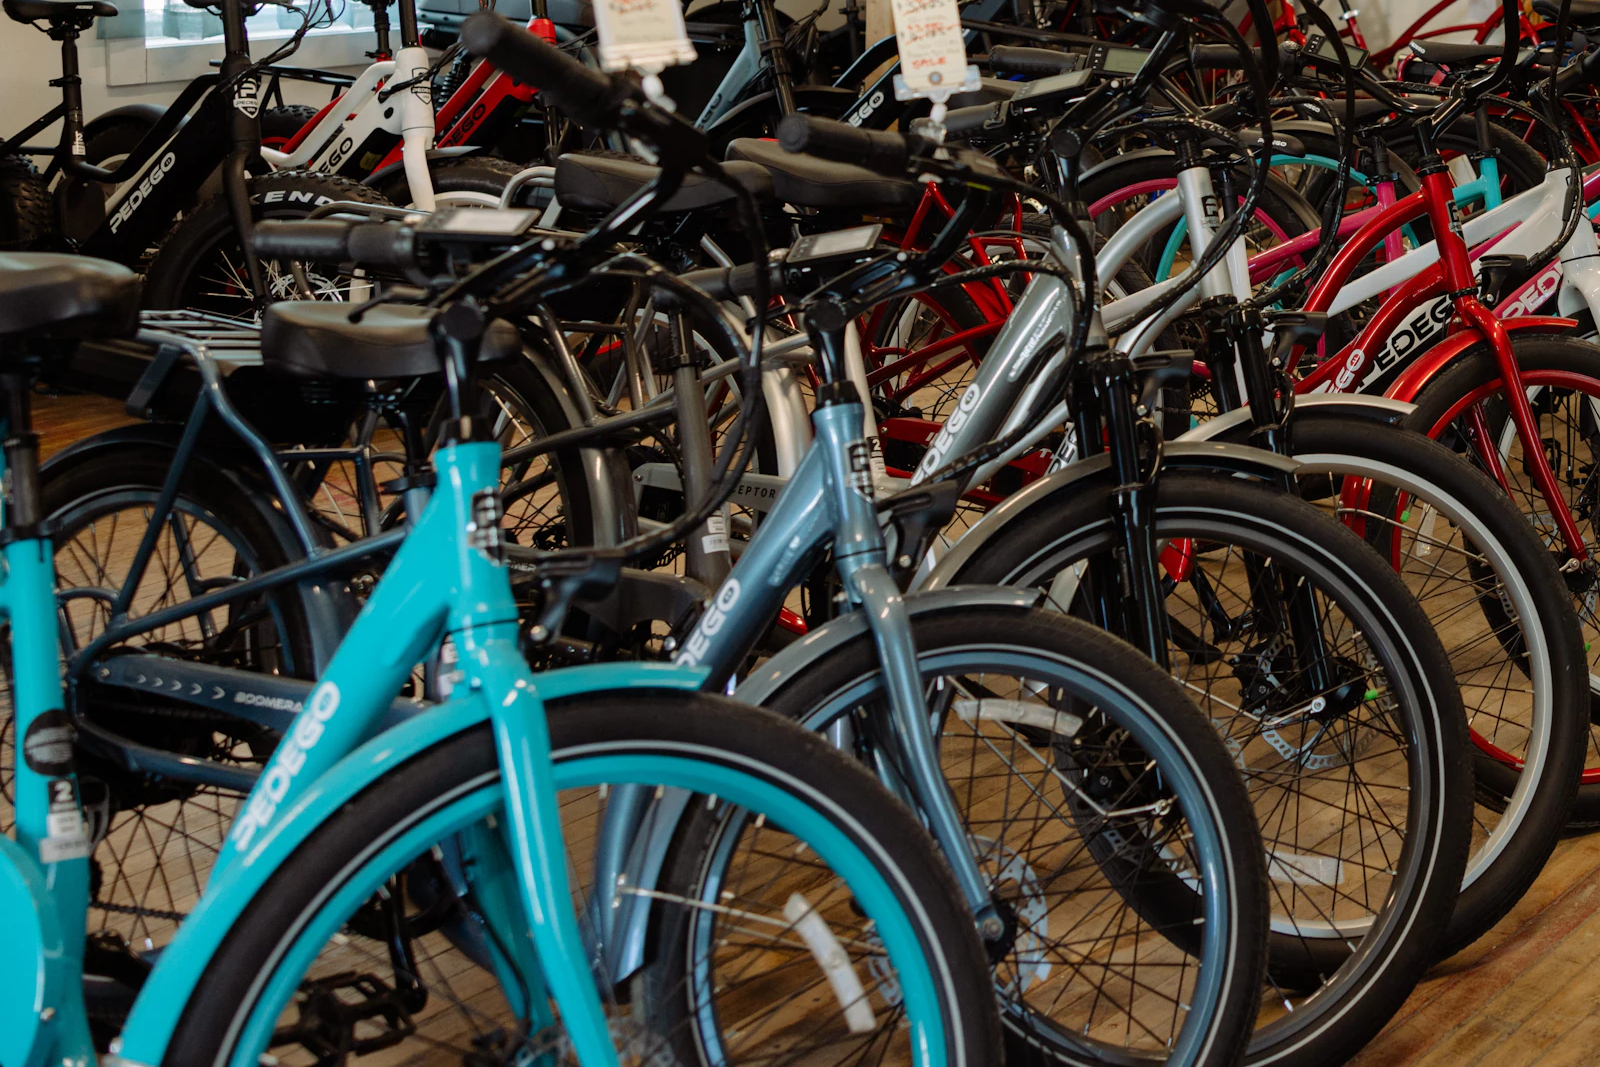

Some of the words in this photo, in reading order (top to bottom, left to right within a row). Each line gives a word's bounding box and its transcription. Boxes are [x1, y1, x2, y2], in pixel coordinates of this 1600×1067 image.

[912, 56, 947, 70] SALE
[848, 91, 885, 128] EGO
[317, 136, 354, 173] EGO
[109, 152, 176, 234] PEDEGO
[250, 190, 335, 207] KEND
[911, 382, 980, 487] EDEGO
[677, 577, 742, 670] DEGO
[234, 693, 303, 717] BOOMERA
[232, 680, 342, 852] PEDEGO
